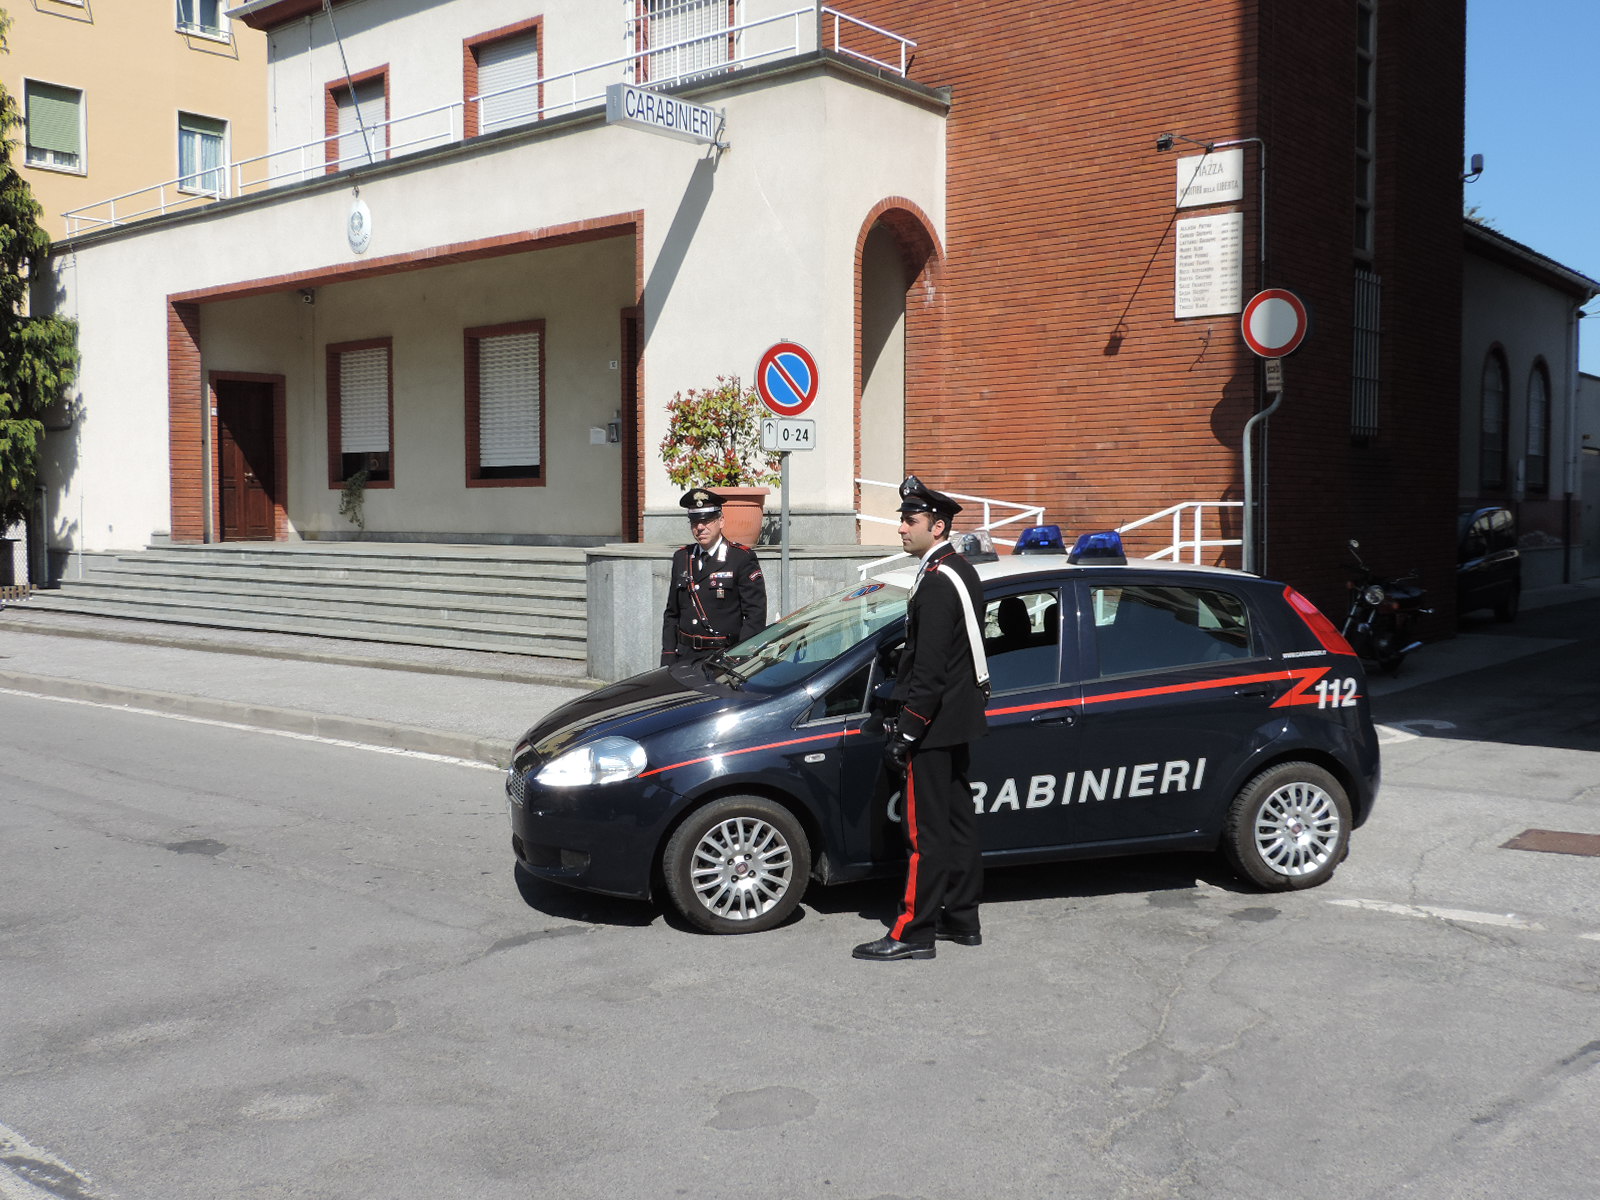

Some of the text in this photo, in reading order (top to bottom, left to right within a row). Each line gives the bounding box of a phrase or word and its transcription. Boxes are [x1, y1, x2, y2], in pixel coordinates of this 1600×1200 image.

[625, 89, 712, 137] CARABINIERI
[1195, 162, 1224, 177] PIAZZA
[782, 428, 809, 442] 0-24
[1314, 677, 1357, 709] 112
[887, 757, 1207, 823] CRABINIERI
